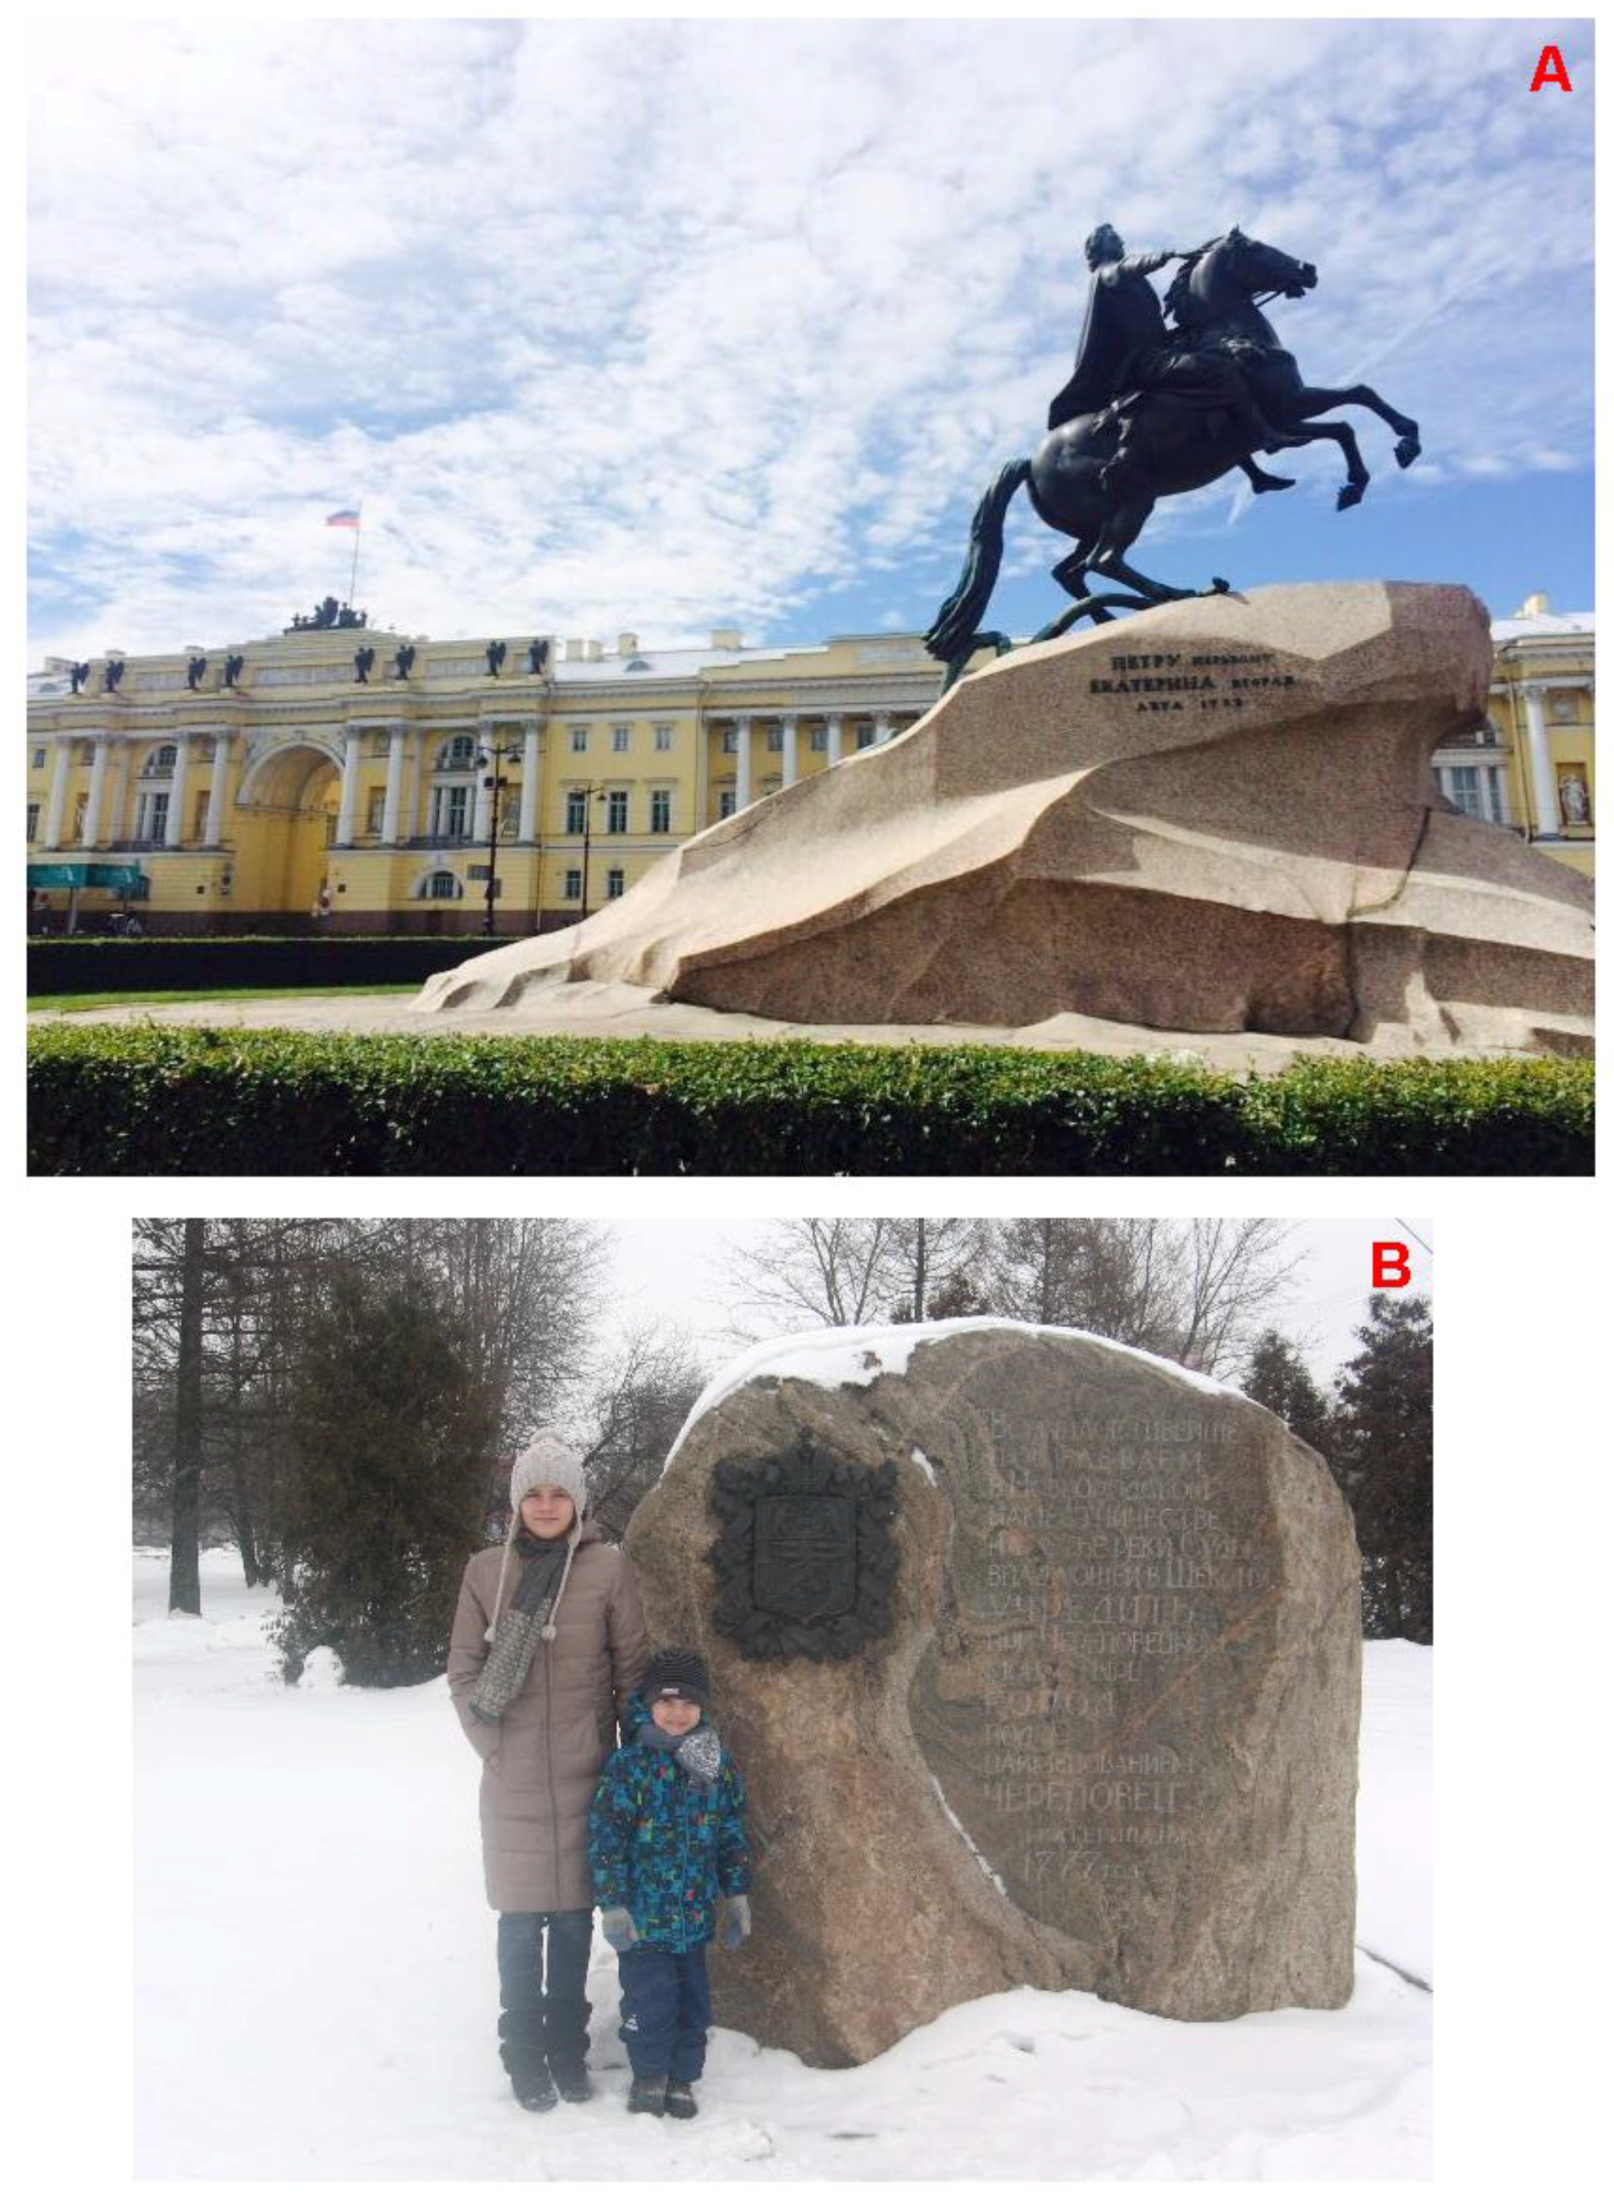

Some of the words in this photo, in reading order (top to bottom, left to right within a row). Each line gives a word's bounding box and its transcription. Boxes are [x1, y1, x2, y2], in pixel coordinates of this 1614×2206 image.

[1111, 654, 1181, 670] ПЕТРУ
[1090, 676, 1216, 693] ЕКАТЕРИНА
[1022, 1850, 1103, 1880] 1777
